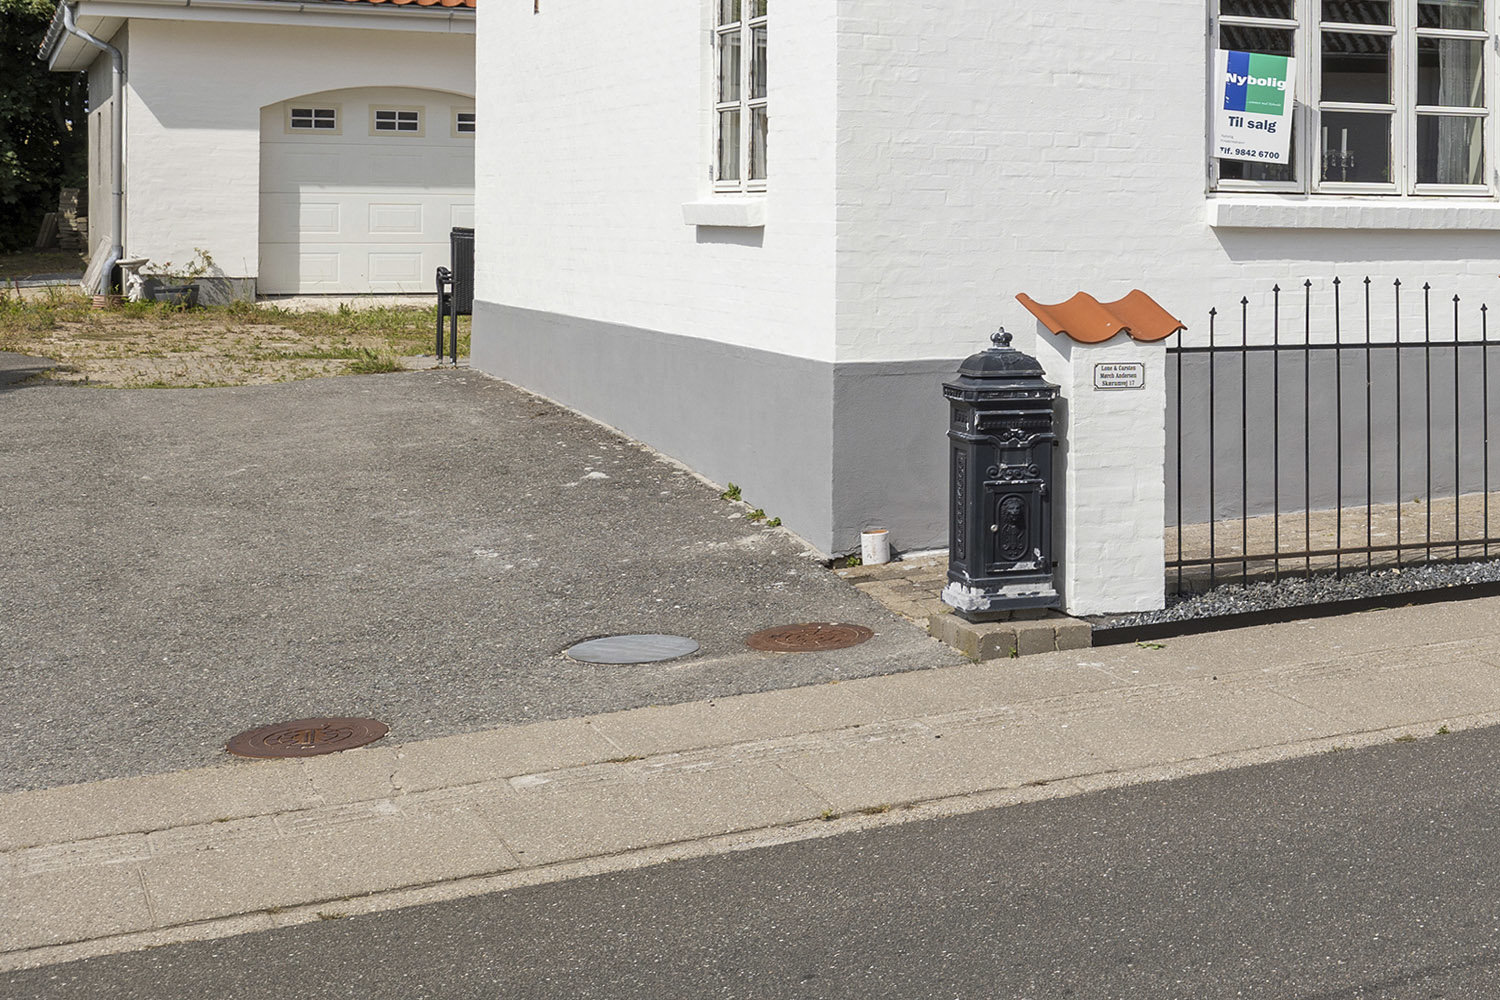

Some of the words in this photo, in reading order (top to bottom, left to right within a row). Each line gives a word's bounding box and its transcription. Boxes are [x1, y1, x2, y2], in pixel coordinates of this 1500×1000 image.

[1225, 73, 1286, 91] Nybolig
[1228, 115, 1243, 127] Til
[1247, 120, 1277, 133] salg
[1235, 148, 1256, 157] 9842
[1258, 151, 1280, 159] 6700
